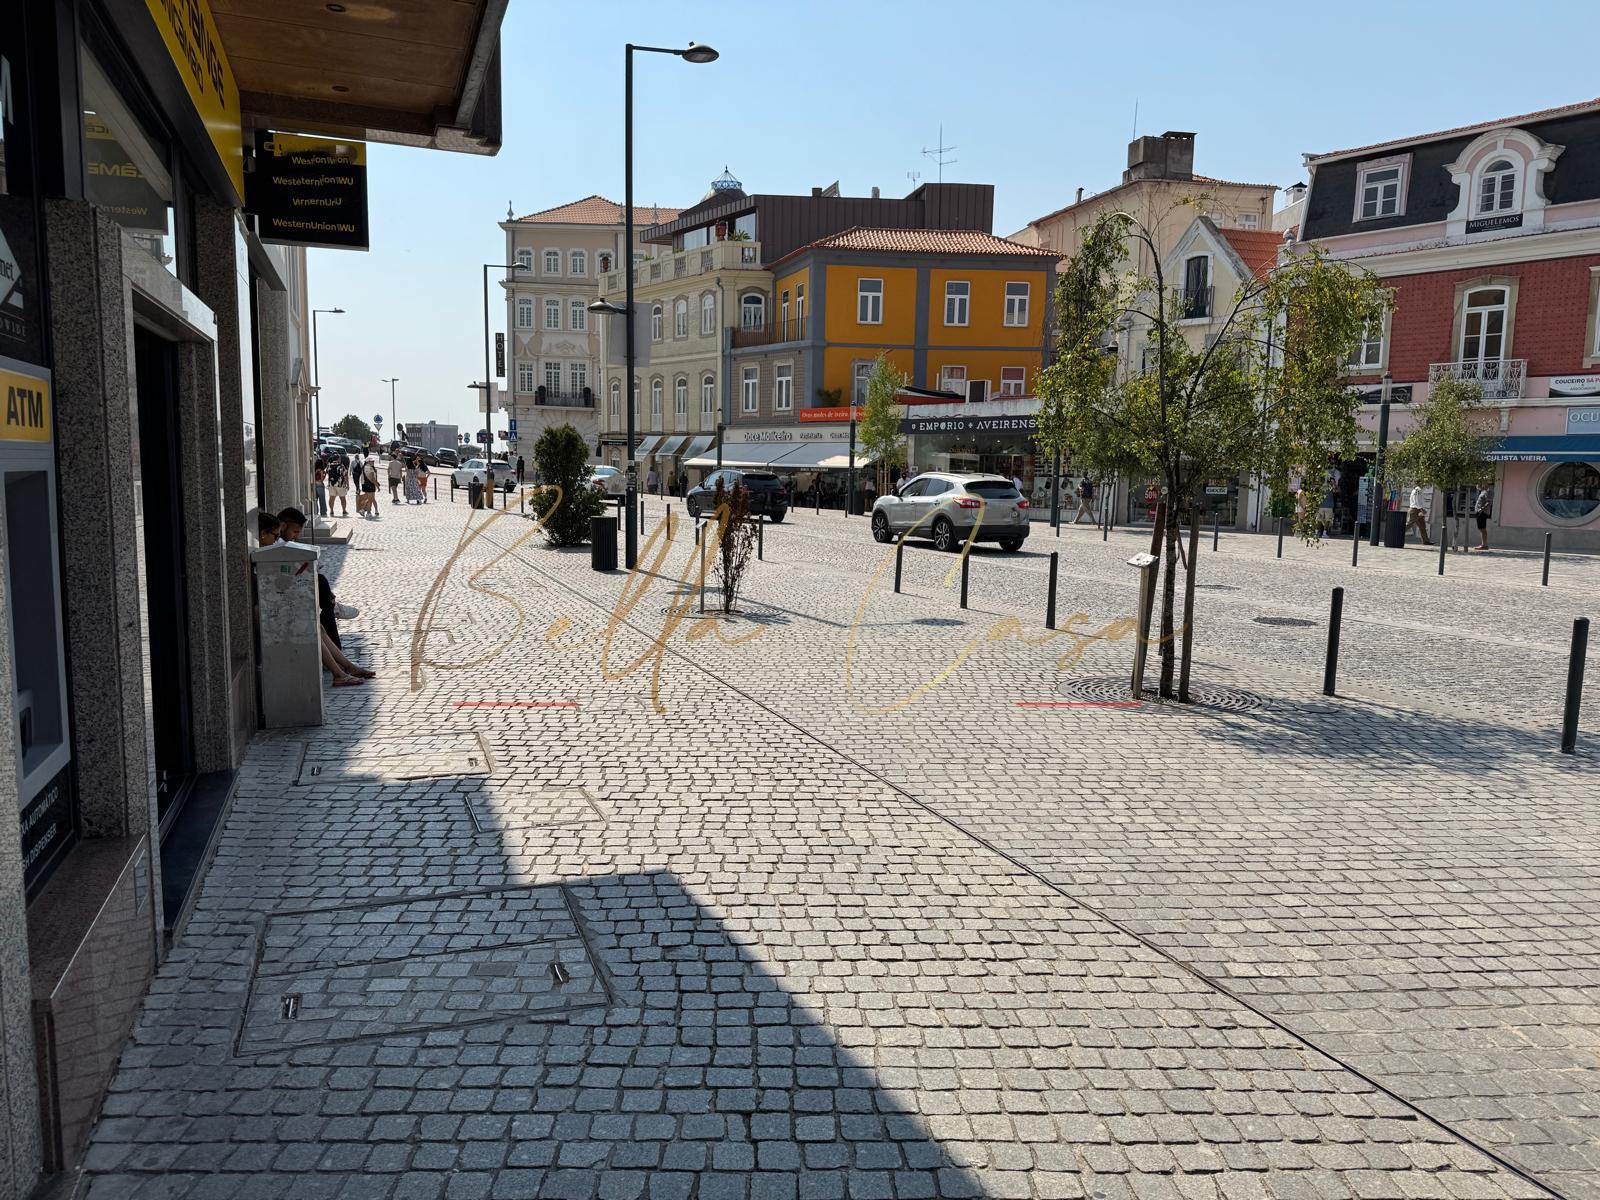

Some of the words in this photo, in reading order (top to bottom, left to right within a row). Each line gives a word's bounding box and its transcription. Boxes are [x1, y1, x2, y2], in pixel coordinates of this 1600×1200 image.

[496, 333, 505, 376] HOTEL
[7, 386, 44, 428] ATM
[976, 418, 1038, 431] AVEIRENS
